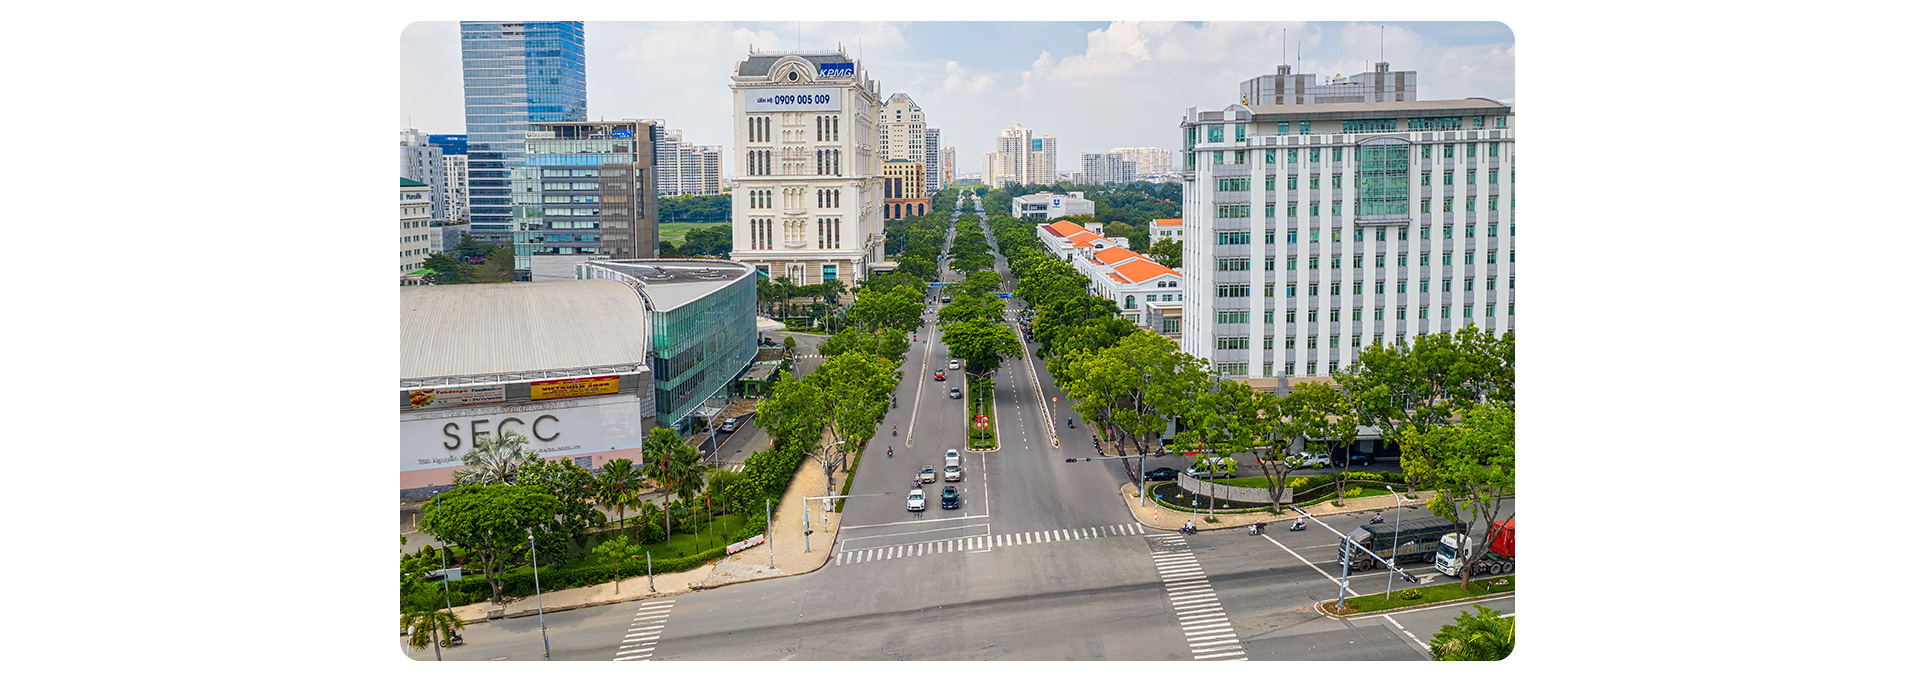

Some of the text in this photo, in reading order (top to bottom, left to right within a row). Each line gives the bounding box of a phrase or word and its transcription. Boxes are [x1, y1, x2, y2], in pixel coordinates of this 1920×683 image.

[819, 68, 852, 78] KPMG
[774, 95, 795, 105] 0909
[797, 94, 813, 105] 005
[814, 94, 830, 104] 009
[443, 414, 561, 450] SECC
